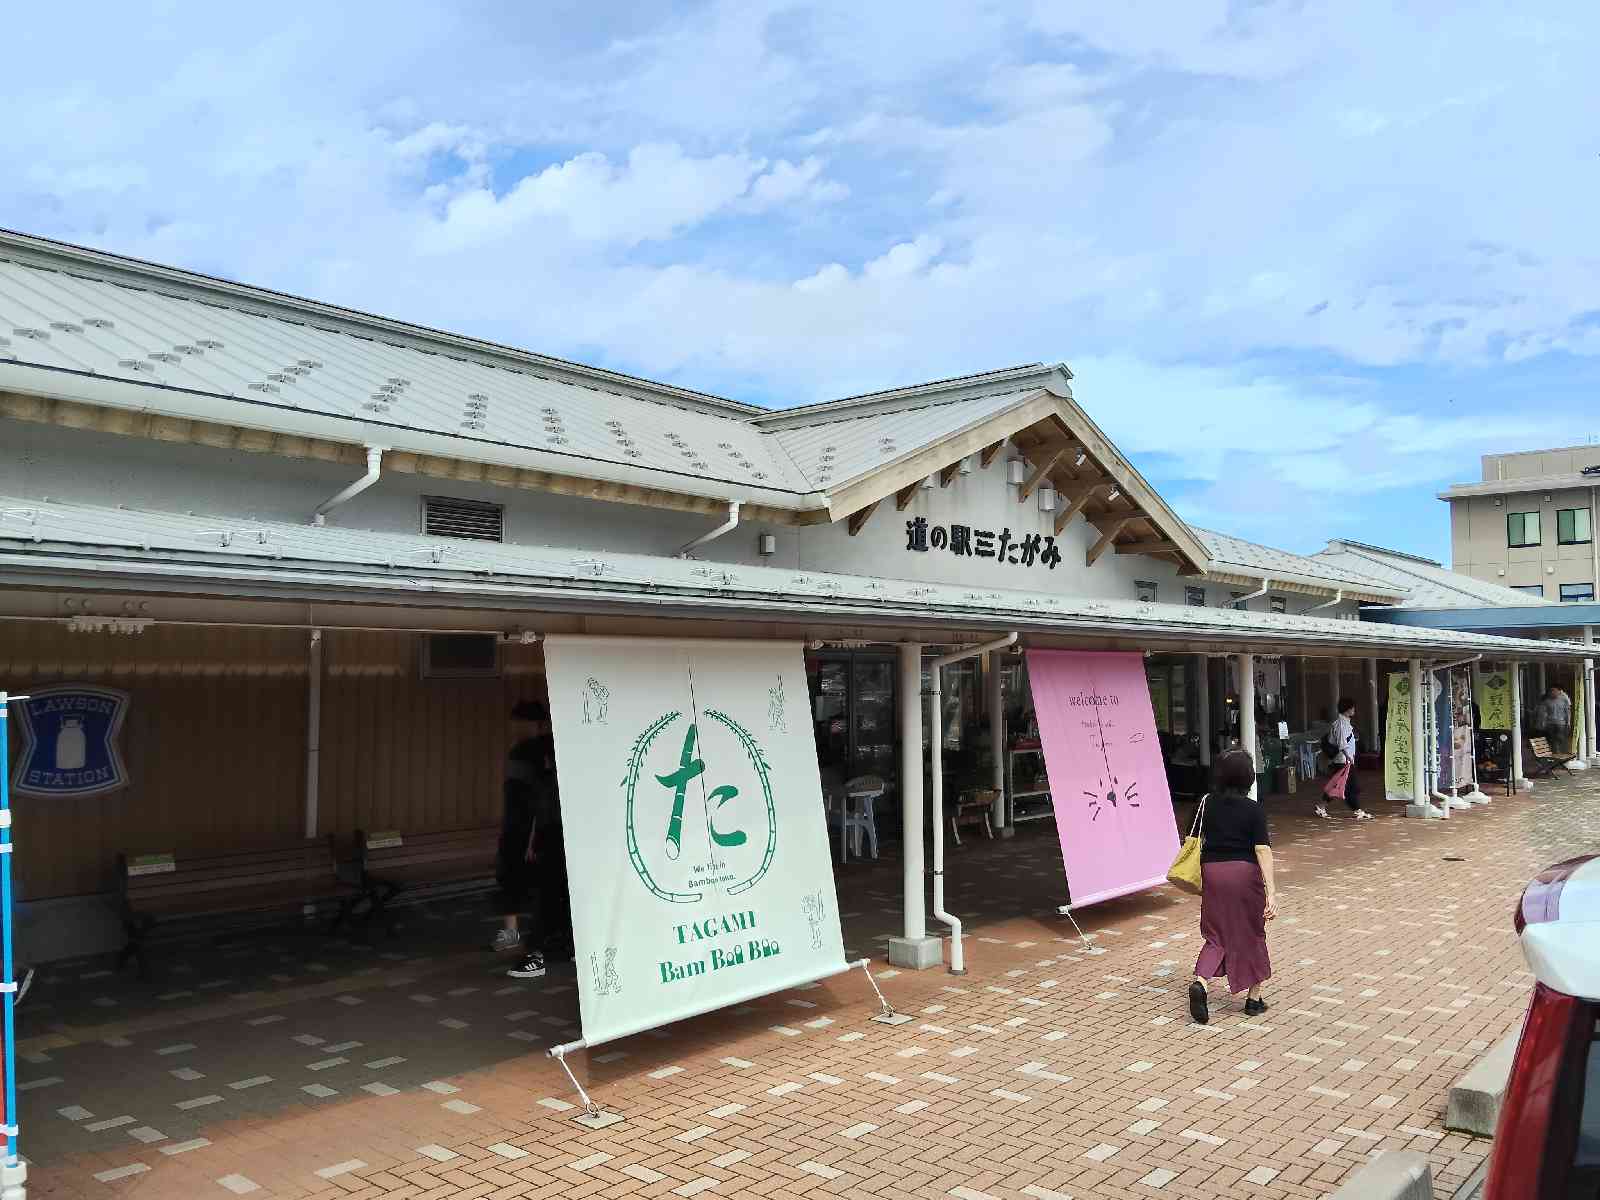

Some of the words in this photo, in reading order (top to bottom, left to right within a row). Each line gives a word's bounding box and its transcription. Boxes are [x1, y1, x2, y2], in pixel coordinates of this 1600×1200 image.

[30, 695, 115, 717] LAWSON
[30, 767, 111, 785] STATION
[654, 723, 748, 861] た
[673, 911, 757, 944] TAGAMI
[657, 960, 705, 983] Bam
